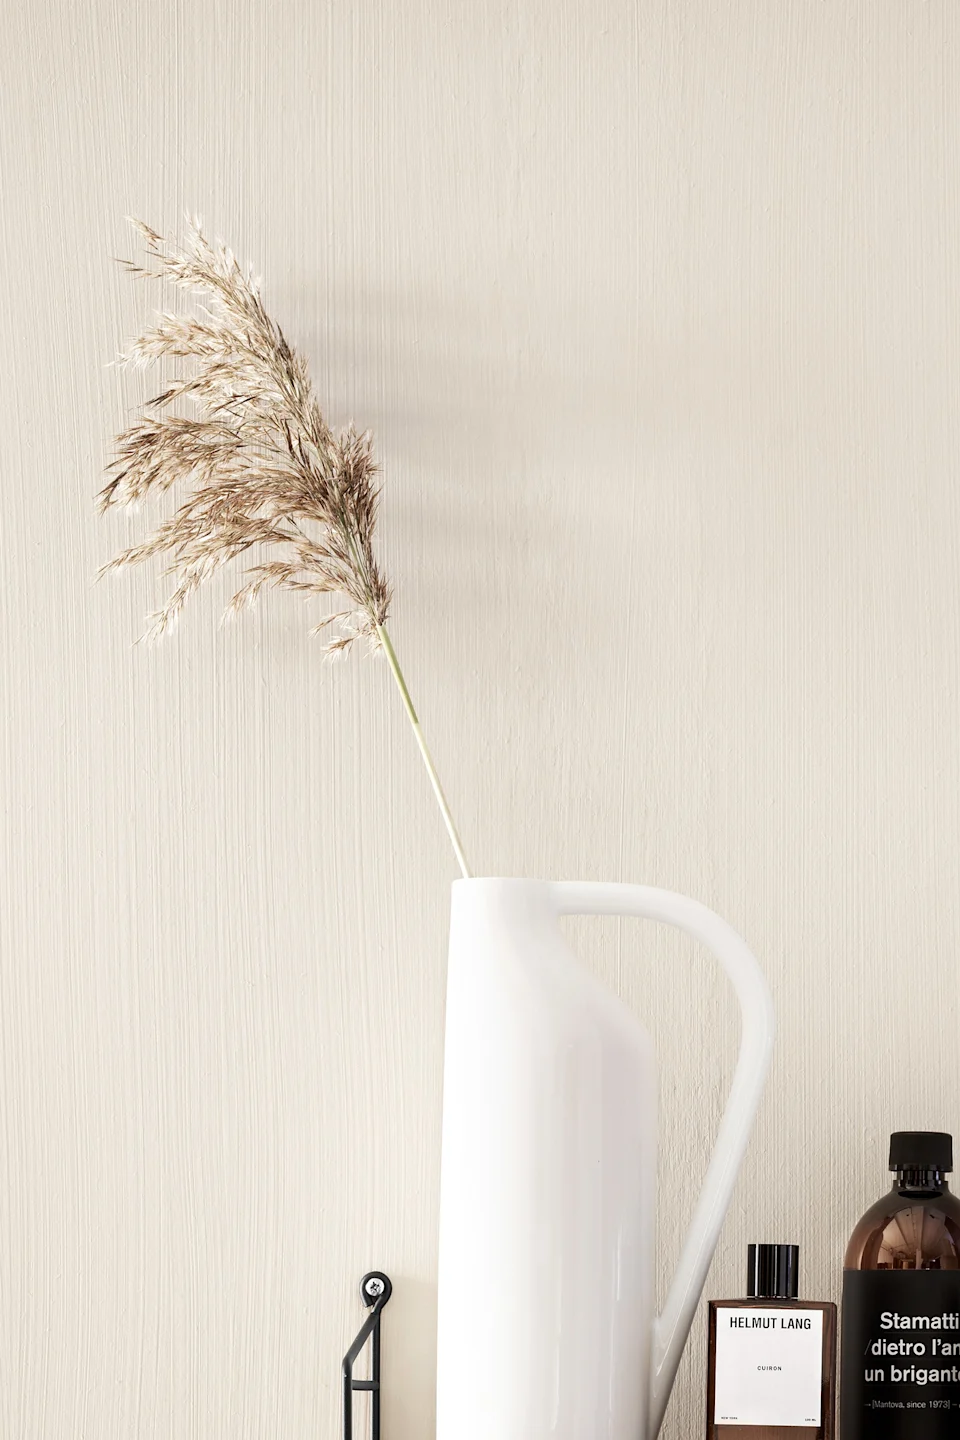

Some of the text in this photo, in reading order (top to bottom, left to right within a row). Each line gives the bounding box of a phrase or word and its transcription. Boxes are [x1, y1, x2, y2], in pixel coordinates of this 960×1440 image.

[730, 1317, 812, 1330] HELMUT LANG
[864, 1368, 885, 1382] un
[906, 1400, 926, 1409] since
[929, 1400, 951, 1410] 1973]
